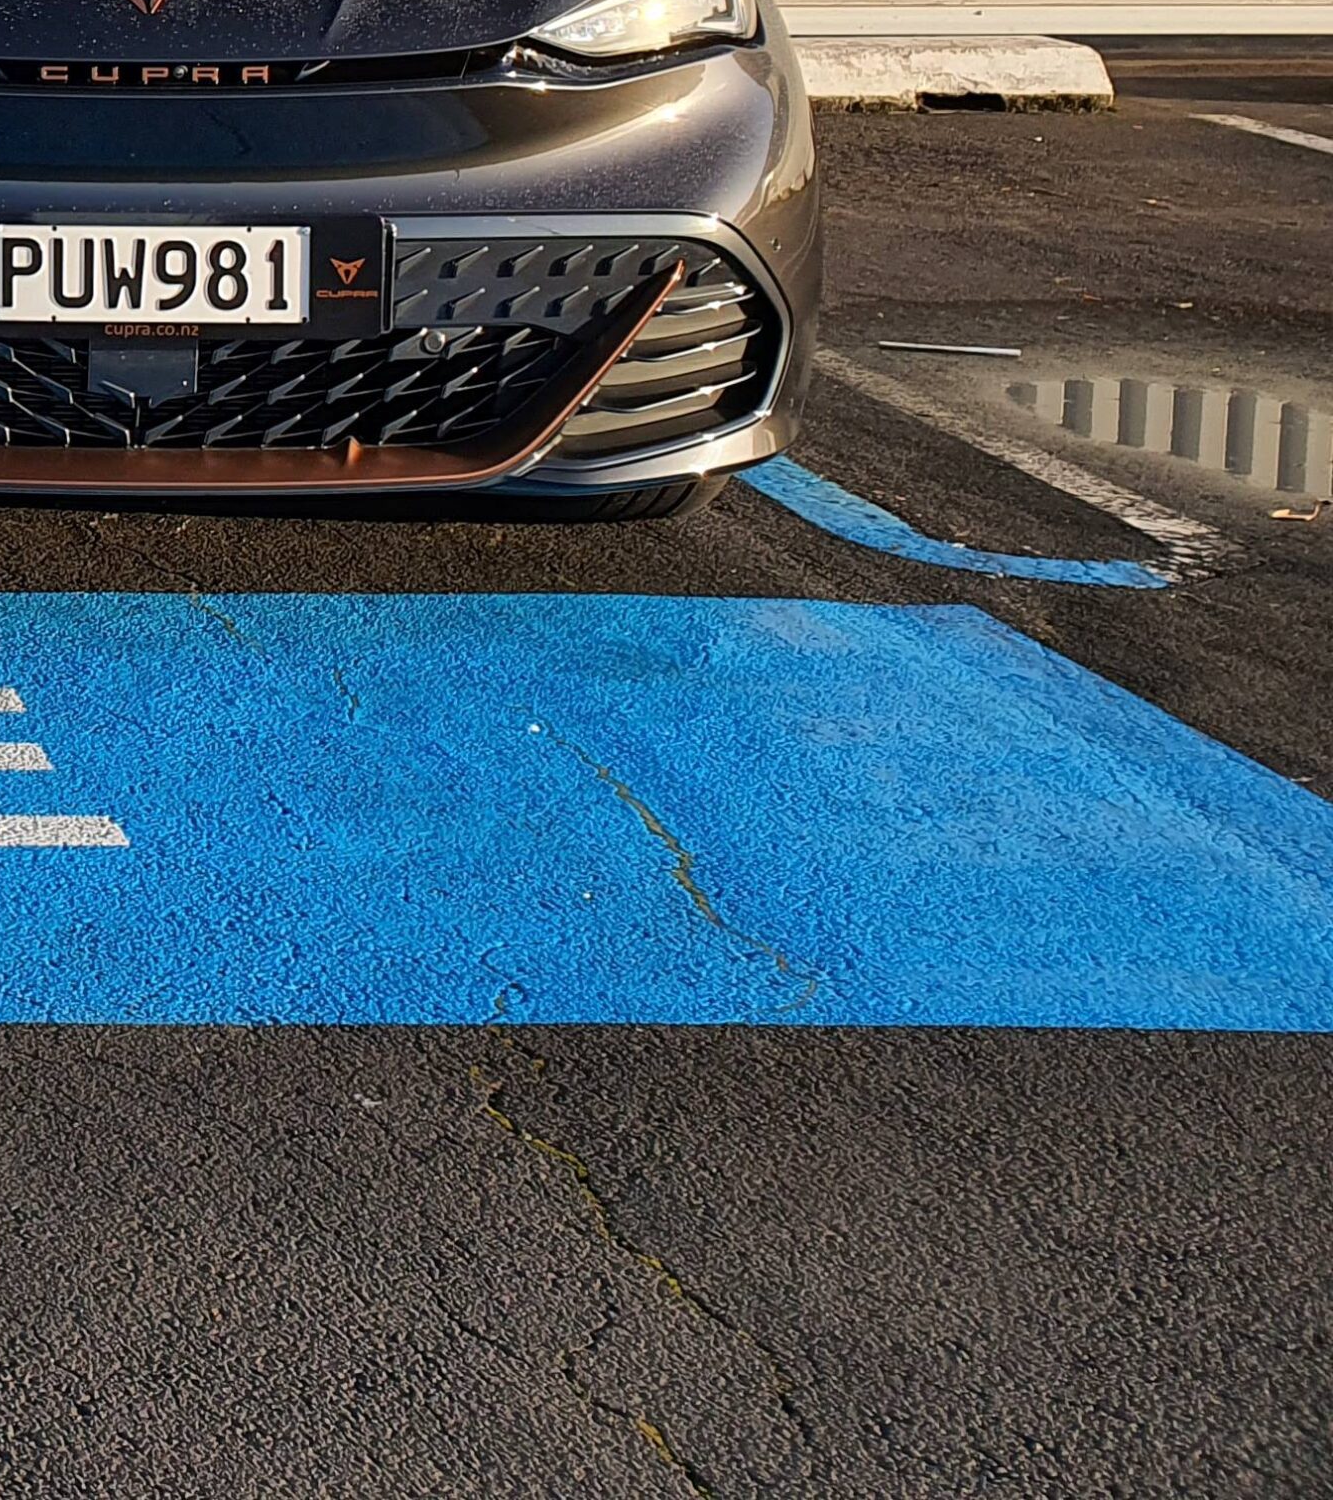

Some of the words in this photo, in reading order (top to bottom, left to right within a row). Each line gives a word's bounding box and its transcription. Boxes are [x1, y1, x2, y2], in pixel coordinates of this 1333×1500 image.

[41, 64, 270, 86] CUPRA
[0, 236, 289, 312] PUW981
[316, 289, 379, 299] CUPRA
[104, 323, 199, 338] cupra.co.nz
